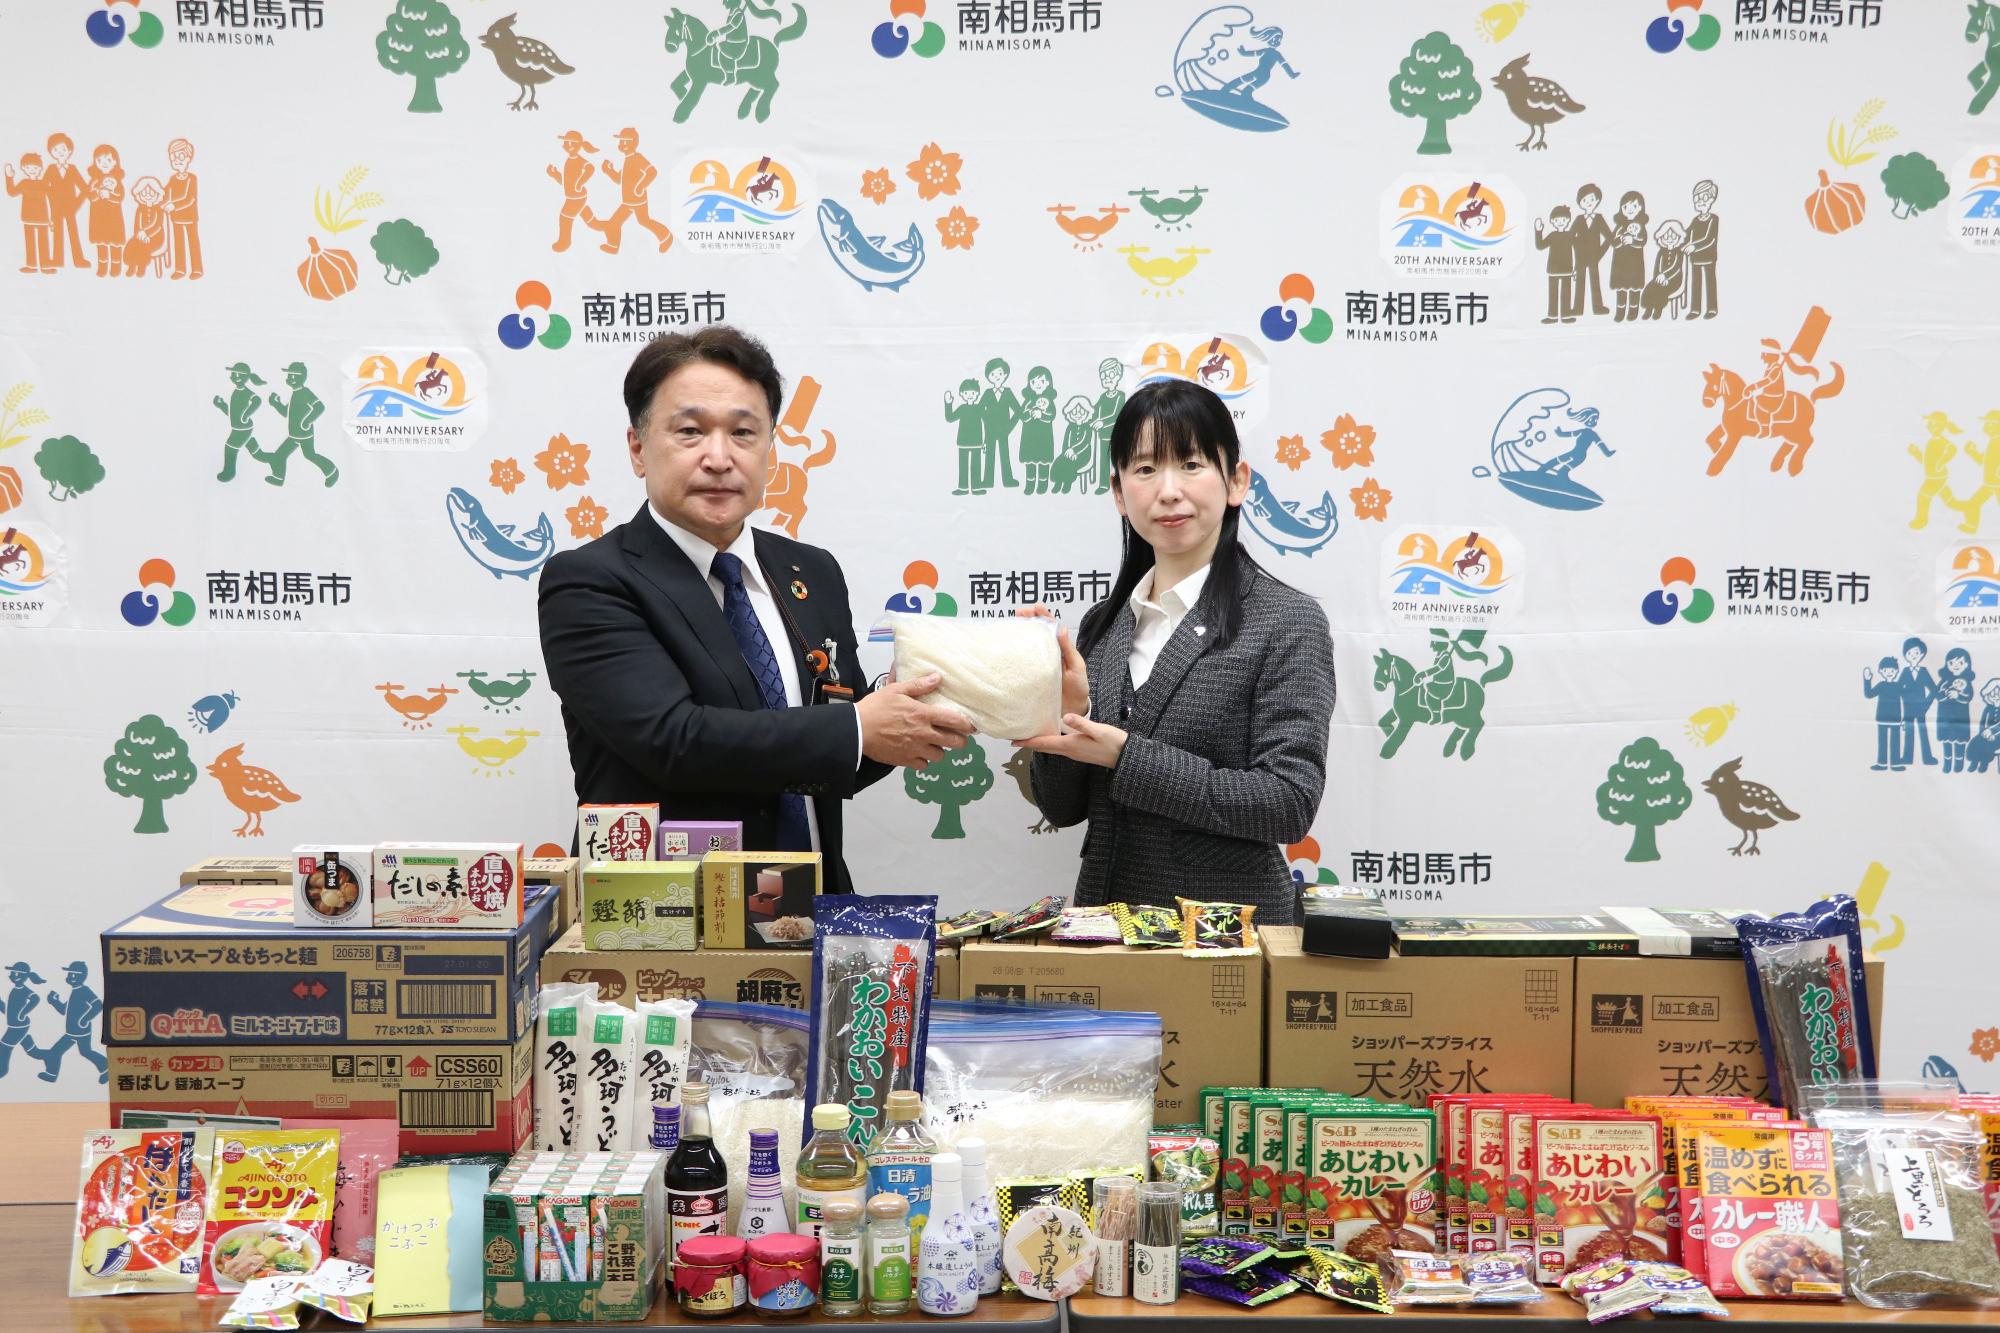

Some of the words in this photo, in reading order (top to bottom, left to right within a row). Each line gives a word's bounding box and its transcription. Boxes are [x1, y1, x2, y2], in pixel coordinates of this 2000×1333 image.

[176, 0, 324, 29] 南相馬市
[957, 0, 1101, 34] 南相馬市
[1735, 0, 1883, 28] 南相馬市
[179, 33, 274, 46] MINAMISOMA
[1735, 29, 1828, 44] MINAMISOMA
[959, 40, 1051, 52] MINAMISOMA
[688, 231, 713, 241] 20TH
[718, 231, 795, 241] ANNIVERSARY
[1961, 226, 1988, 237] 20TH
[1394, 255, 1420, 265] 20TH
[1424, 255, 1503, 267] ANNIVERSARY
[582, 290, 727, 327] 南相馬市
[1345, 290, 1489, 326] 南相馬市
[1347, 329, 1438, 342] MINAMISOMA
[355, 425, 382, 436] 20TH
[386, 425, 465, 437] ANNIVERSARY
[206, 570, 351, 606] 南相馬市
[969, 570, 1110, 605] 南相馬市
[1726, 566, 1870, 603] 南相馬市
[210, 609, 302, 622] MINAMISOMA
[1391, 602, 1418, 613] 20TH
[1422, 603, 1500, 615] ANNIVERSARY
[1728, 604, 1818, 618] MINAMISOMA
[1948, 616, 1976, 626] 20TH
[326, 861, 337, 887] 缶つま
[1351, 850, 1492, 886] 南相馬市
[387, 867, 467, 899] だしの素
[470, 868, 481, 902] 本かつお
[482, 855, 505, 910] 直火焼
[1381, 888, 1442, 901] AMISOMA
[592, 898, 645, 927] 鰹節
[115, 945, 318, 966] うま濃いスープ&もちっと麺
[336, 948, 371, 958] 206758
[637, 970, 677, 985] ビック
[677, 976, 705, 986] シリーズ
[354, 981, 385, 995] 落下
[736, 979, 801, 1002] 胡麻で
[354, 999, 385, 1012] 厳禁
[890, 962, 914, 1048] 下北特産
[1039, 991, 1095, 1006] 加工食品
[1350, 997, 1408, 1013] 加工食品
[1829, 961, 1854, 1049] 下北特産
[1657, 1003, 1714, 1019] 加工食品
[151, 1014, 227, 1037] QTTA
[232, 1015, 340, 1035] ミルキーシーフード味
[375, 1025, 434, 1035] 77g×12食入
[1351, 1035, 1493, 1051] ショッパーズプライス
[117, 1056, 148, 1065] サッポロ
[170, 1057, 223, 1070] カップ麺
[440, 1058, 498, 1074] CSS60
[846, 975, 892, 1155] わかおいこん
[412, 1066, 426, 1077] UP
[619, 1061, 628, 1082] たか
[640, 1050, 676, 1102] 多珂
[671, 1062, 680, 1083] たか
[1353, 1058, 1492, 1098] 天然水
[118, 1075, 169, 1091] 香ばし
[175, 1076, 246, 1090] 醤油スープ
[436, 1078, 502, 1089] 71g×12個入
[588, 1048, 624, 1151] 多珂うど
[1322, 1125, 1357, 1137] S&B
[1547, 1127, 1582, 1140] S&B
[874, 1156, 930, 1165] コレステロールゼロ
[1320, 1149, 1424, 1173] あじわい
[1704, 1147, 1788, 1170] 温めずに
[1794, 1151, 1824, 1161] 6ヶ月
[1546, 1153, 1652, 1178] あじわい
[238, 1173, 307, 1183] AJINOMOTO
[888, 1168, 916, 1183] 日清
[1340, 1175, 1407, 1198] カレー
[1568, 1179, 1635, 1203] カレー
[1706, 1171, 1832, 1197] 食べられる
[223, 1186, 319, 1210] コンソメ
[546, 1196, 582, 1204] KAGOME
[1182, 1191, 1215, 1211] れん草
[1411, 1190, 1430, 1200] 旨み
[1711, 1199, 1829, 1234] カレー職人
[674, 1221, 701, 1229] KNK
[1228, 1227, 1246, 1235] 甘口
[1067, 1225, 1083, 1260] 紀州
[1475, 1240, 1495, 1251] 中辛
[1714, 1236, 1738, 1246] 中辛
[1031, 1212, 1062, 1293] 南高梅
[1542, 1254, 1562, 1264] 中辛
[831, 1266, 846, 1274] 昆布
[927, 1261, 973, 1271] 本醸造しょうゆ
[1411, 1259, 1451, 1270] 減塩
[1473, 1261, 1513, 1272] 減塩
[1471, 1271, 1522, 1284] とうふ
[1647, 1277, 1702, 1291] とうふ
